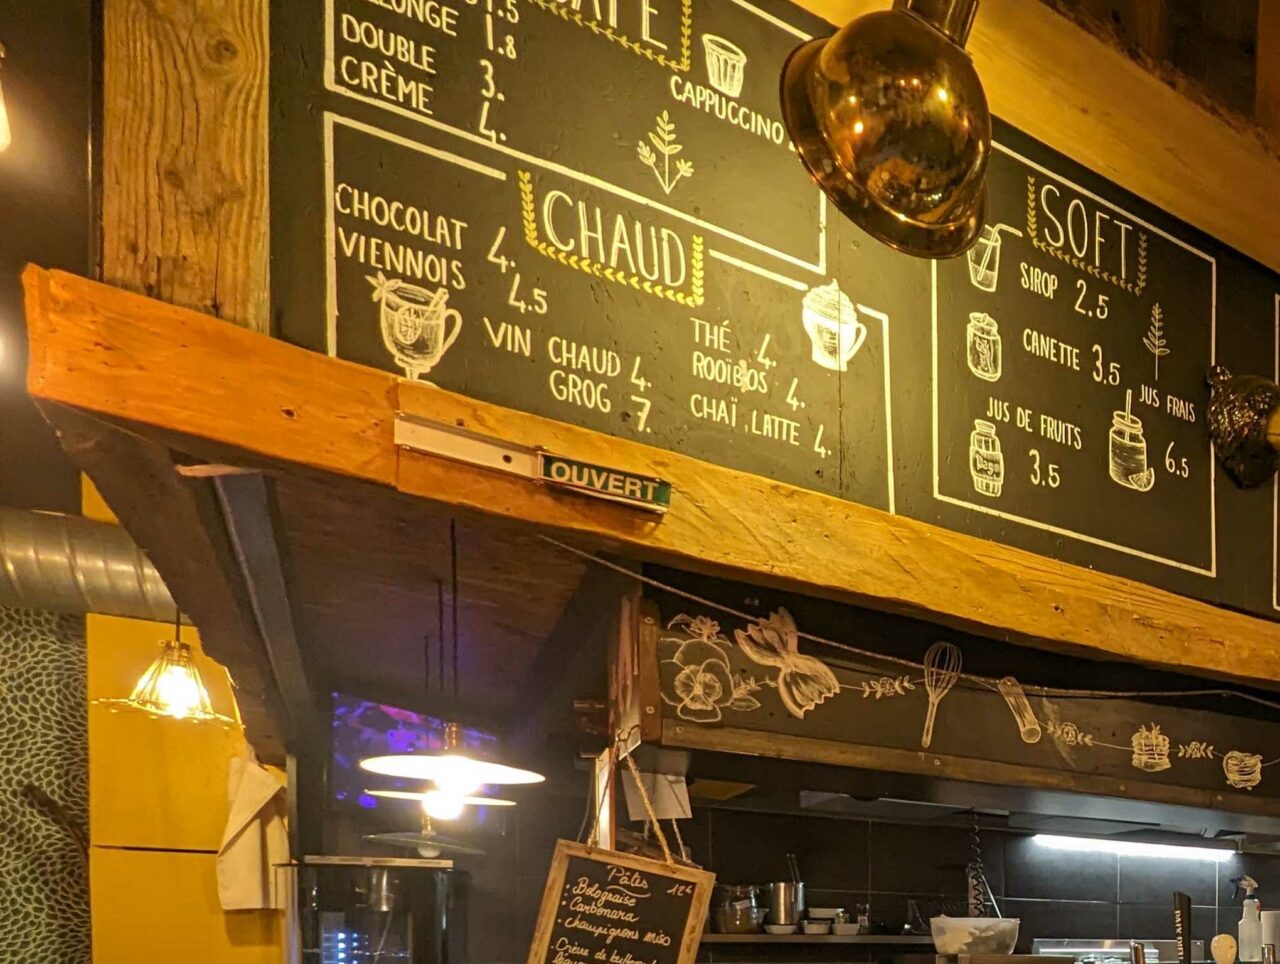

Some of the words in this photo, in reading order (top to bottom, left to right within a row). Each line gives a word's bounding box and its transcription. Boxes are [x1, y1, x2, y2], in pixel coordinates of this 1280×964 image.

[341, 13, 437, 74] DOUBLE
[340, 55, 434, 115] CRÈME
[669, 75, 785, 146] CAPPUCCINO
[334, 183, 468, 250] CHOCOLAT
[542, 189, 687, 288] CHAUD
[1039, 184, 1134, 280] SOFT
[337, 227, 467, 291] VIENNOIS
[1020, 262, 1059, 300] SIROP
[1073, 279, 1110, 321] 2.5
[482, 316, 533, 357] VIN
[548, 335, 622, 377] CHAUD
[690, 317, 732, 354] THÉ
[1023, 328, 1080, 372] CANETTE
[1092, 345, 1121, 387] 3.5
[549, 370, 612, 413] GROG
[690, 393, 738, 428] CHAÏ
[1138, 384, 1161, 409] JUS
[1165, 395, 1197, 424] FRAIS
[986, 397, 1011, 423] JUS
[1016, 406, 1032, 429] DE
[1040, 415, 1083, 450] FRUITS
[550, 462, 660, 502] OUVERT
[1028, 448, 1062, 489] 3.5
[1164, 441, 1190, 479] 6.5
[572, 876, 638, 907] Bolognaise
[606, 864, 649, 889] Pâtes
[569, 896, 640, 923] Carbonara
[643, 929, 671, 946] miso
